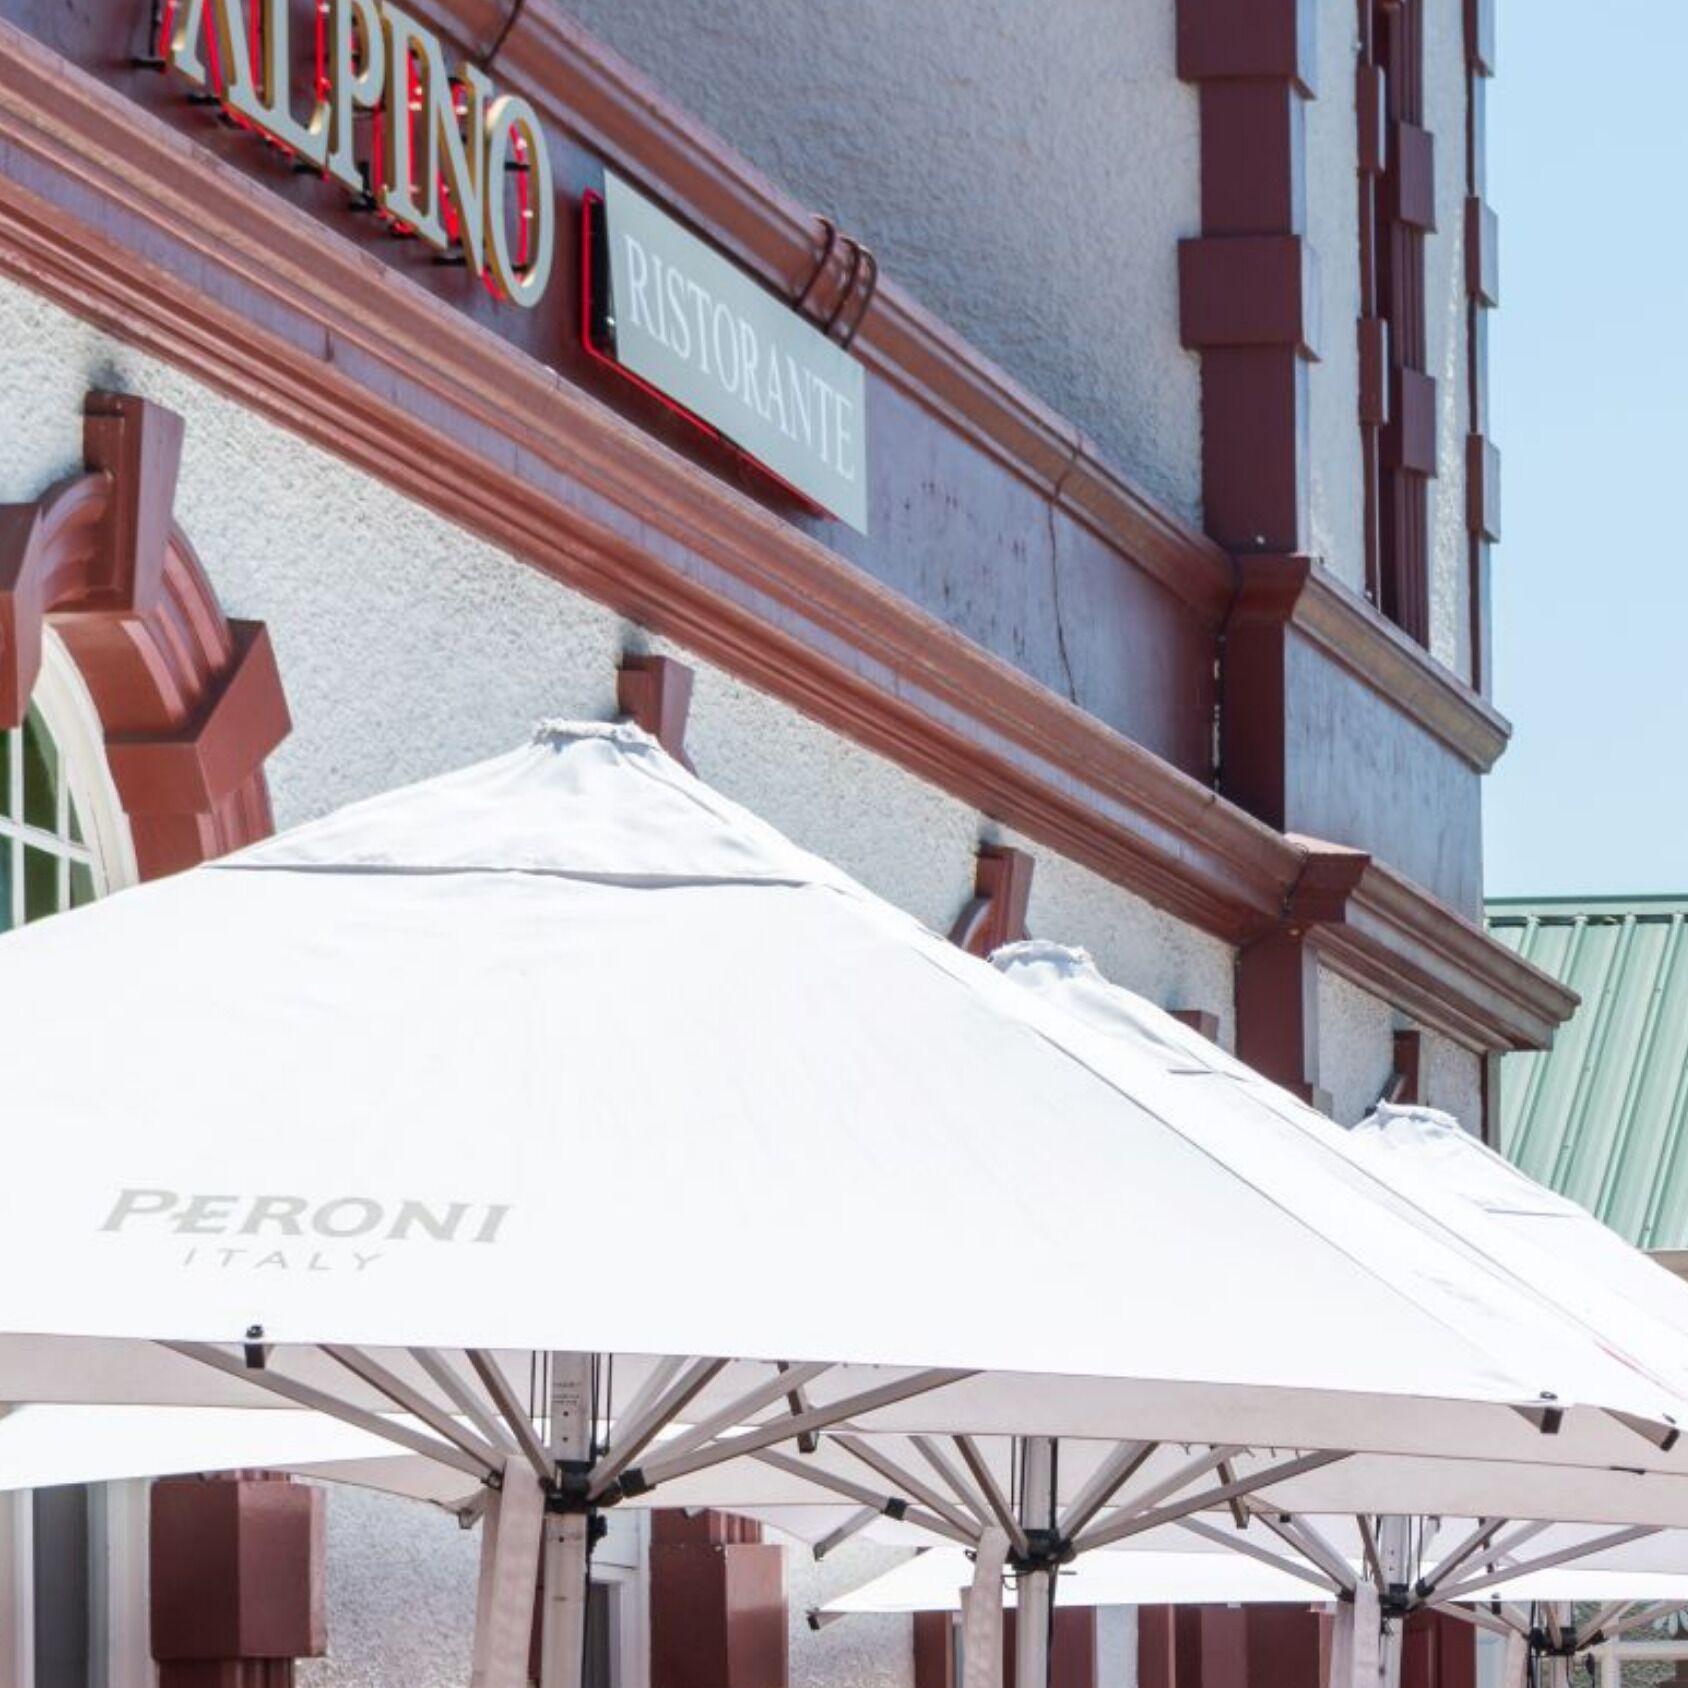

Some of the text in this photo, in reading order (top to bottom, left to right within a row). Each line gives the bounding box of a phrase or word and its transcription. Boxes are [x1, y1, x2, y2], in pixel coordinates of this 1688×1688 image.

[624, 233, 855, 483] RISTORANTE
[97, 1187, 512, 1245] PERONI
[182, 1247, 380, 1271] ITALY
